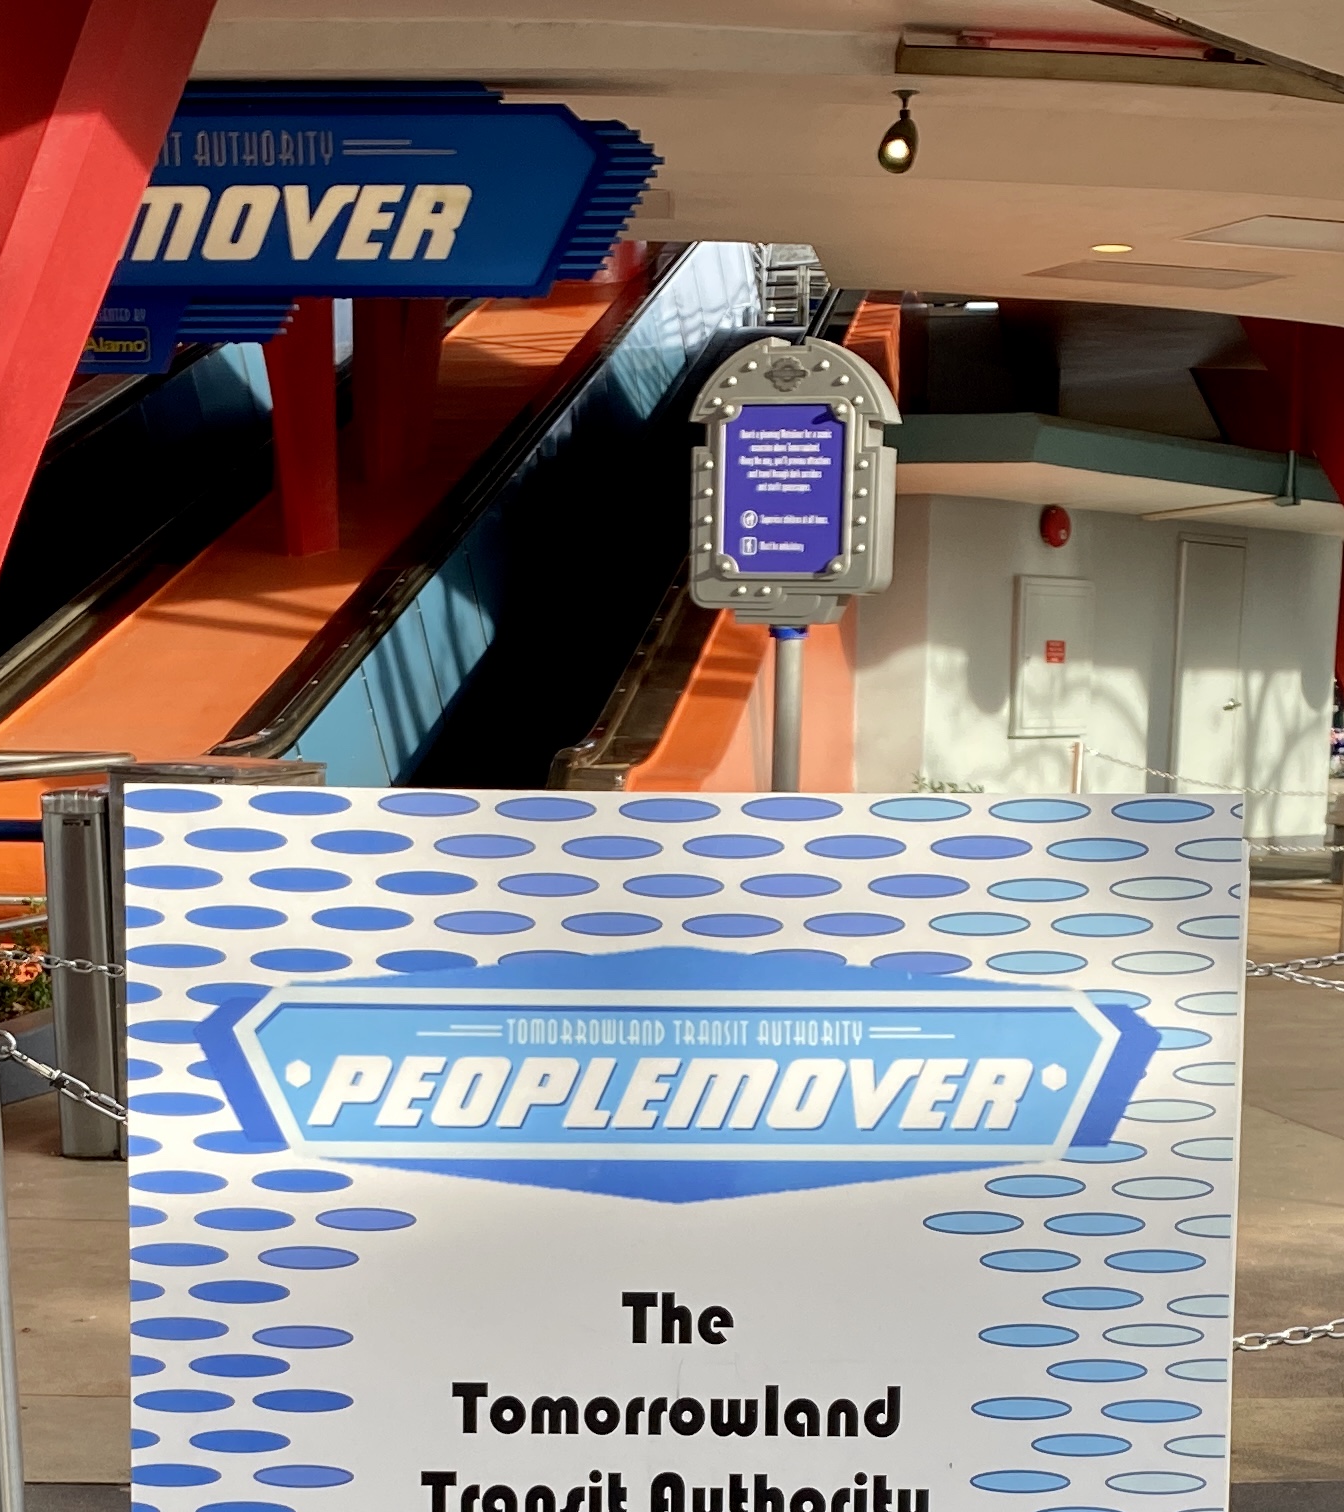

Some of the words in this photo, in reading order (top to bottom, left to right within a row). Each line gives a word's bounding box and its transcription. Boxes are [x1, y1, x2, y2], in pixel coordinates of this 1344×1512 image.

[157, 131, 183, 167] IT
[193, 130, 334, 167] AUTHORITY
[84, 336, 145, 352] Alamo
[506, 1018, 666, 1047] TOMORROWLAND
[672, 1019, 750, 1047] TRANSIT
[757, 1019, 863, 1047] AUTHORITY
[308, 1055, 1030, 1132] PEOPLEMOVER
[621, 1291, 734, 1345] The
[451, 1381, 901, 1438] Tomorrowland
